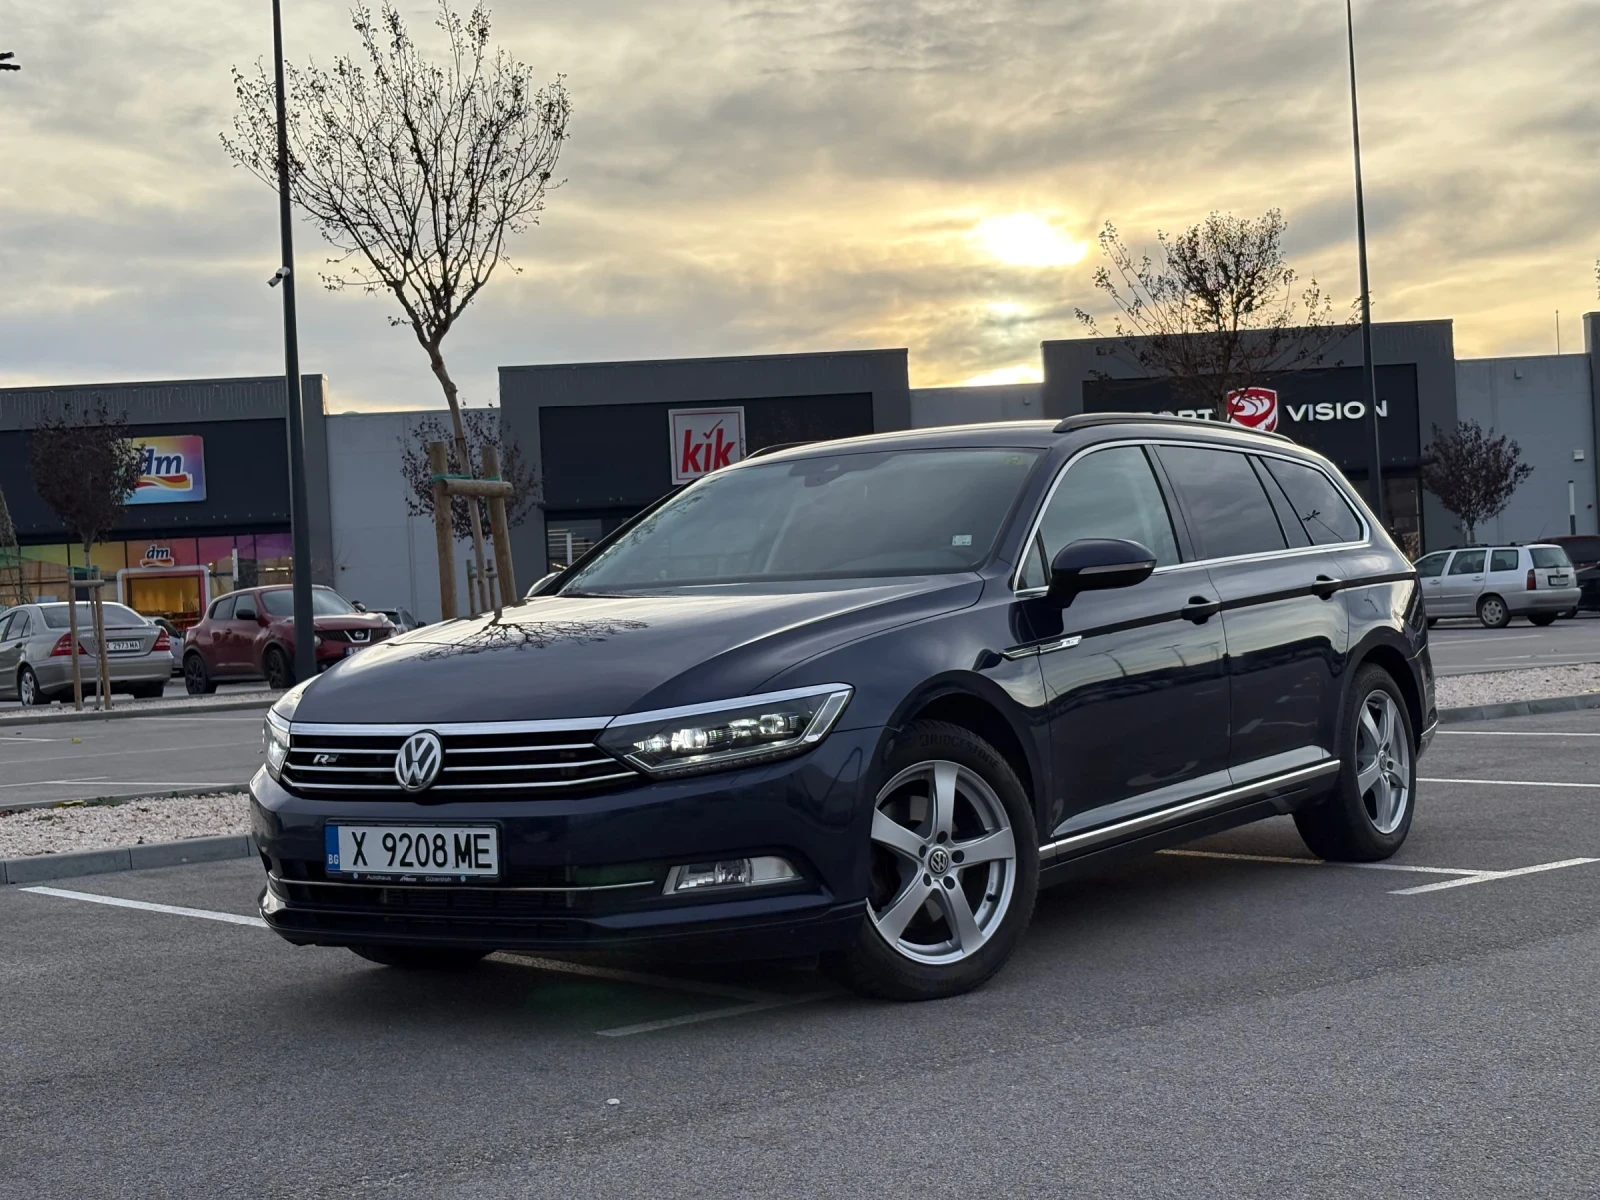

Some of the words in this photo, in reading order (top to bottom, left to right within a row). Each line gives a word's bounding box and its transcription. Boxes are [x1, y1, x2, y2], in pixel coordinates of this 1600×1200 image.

[1285, 400, 1388, 422] VISION
[681, 419, 736, 473] kik
[139, 448, 182, 475] dm
[146, 545, 169, 559] dm
[328, 853, 339, 865] BG
[351, 831, 368, 867] X
[382, 832, 448, 868] 9208
[453, 833, 492, 869] ME
